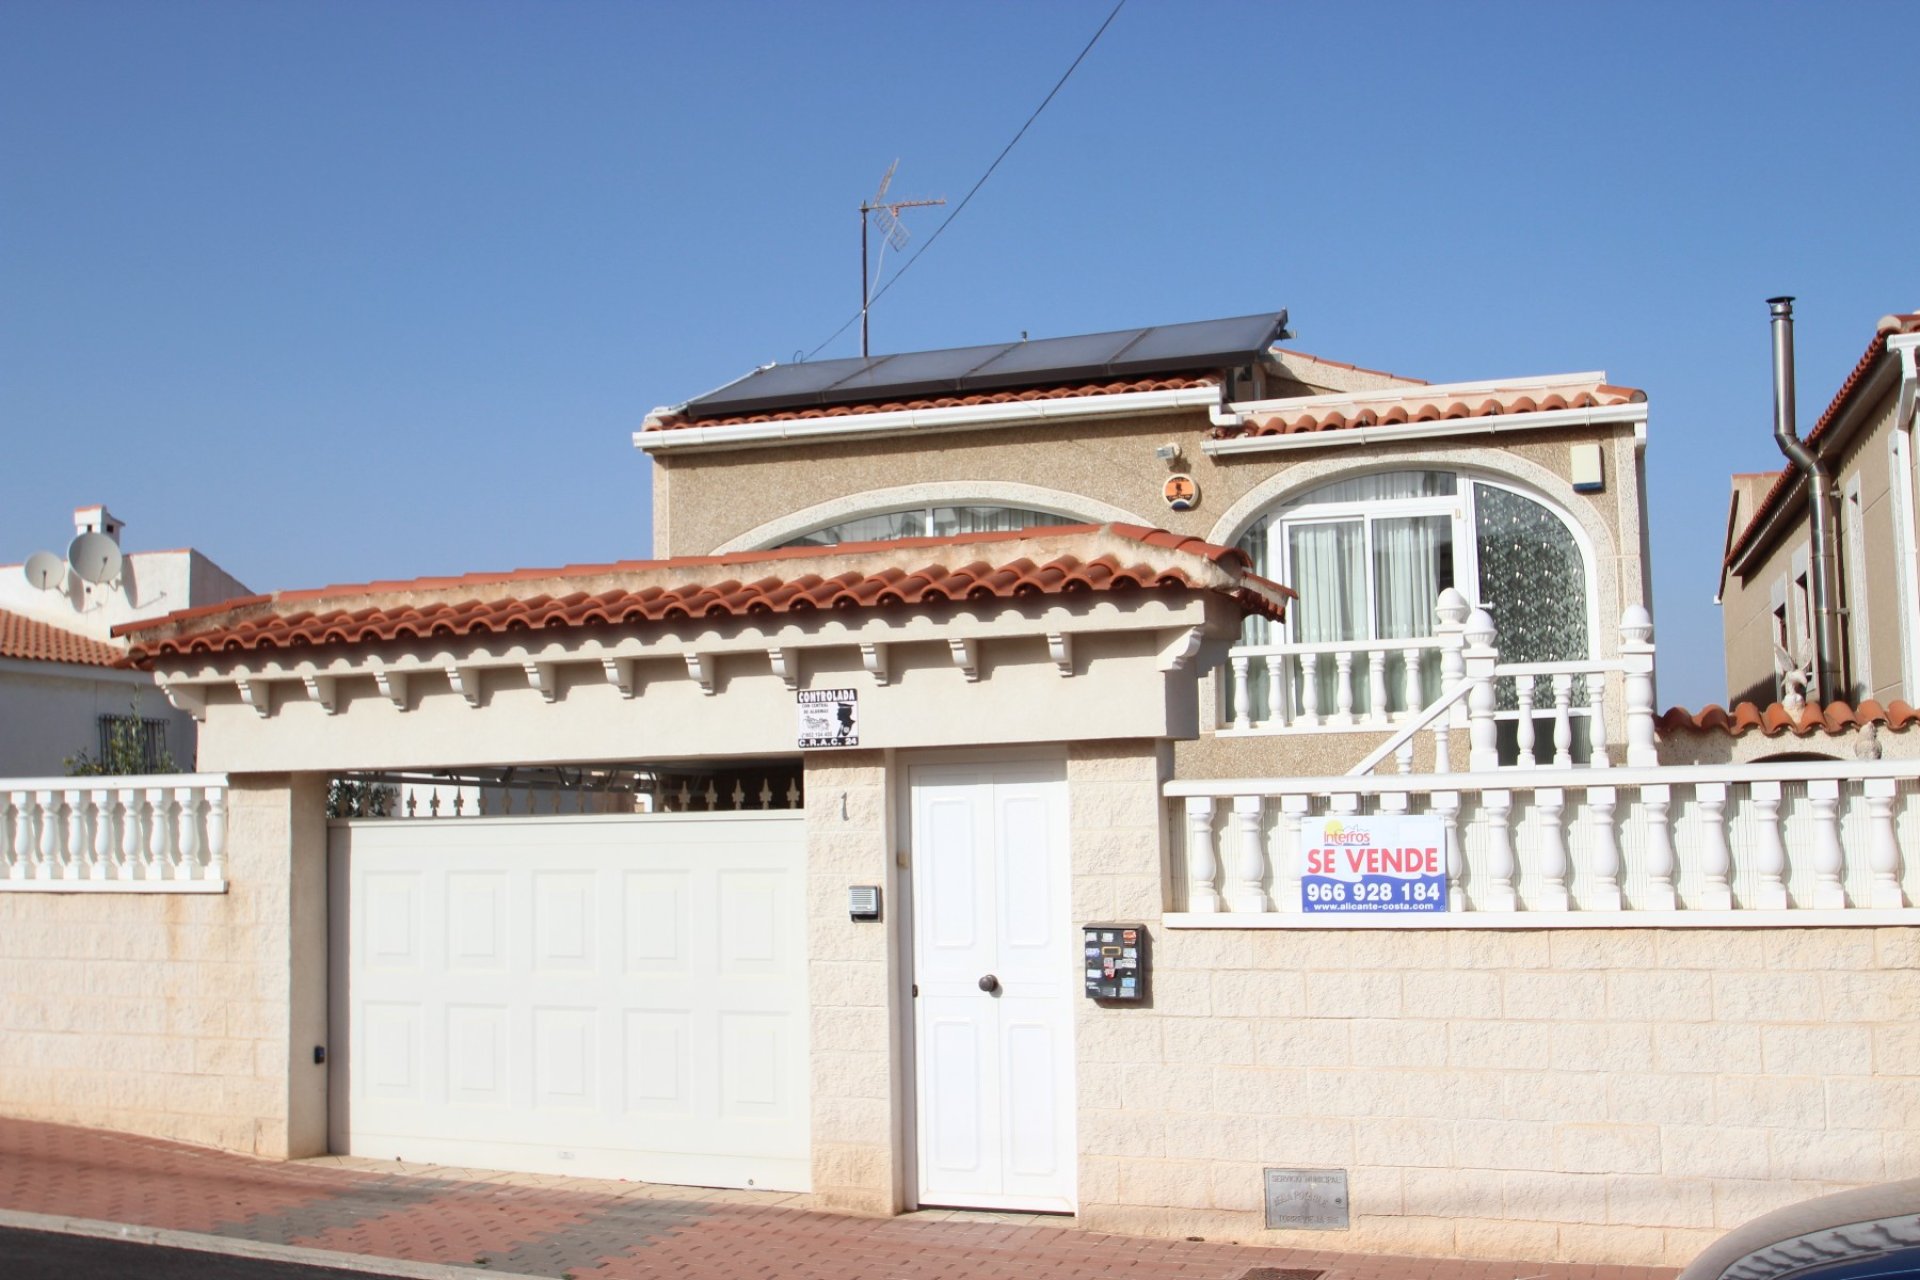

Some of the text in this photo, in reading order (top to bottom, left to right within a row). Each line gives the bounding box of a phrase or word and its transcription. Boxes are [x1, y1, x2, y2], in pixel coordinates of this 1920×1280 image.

[798, 690, 855, 703] CONTROLADA
[799, 737, 857, 747] C.R.A.C. 24
[1324, 831, 1370, 845] Interros
[1307, 848, 1438, 874] SE VENDE
[1307, 882, 1440, 902] 966 928 184
[1313, 902, 1434, 911] www.alicante-costa.com
